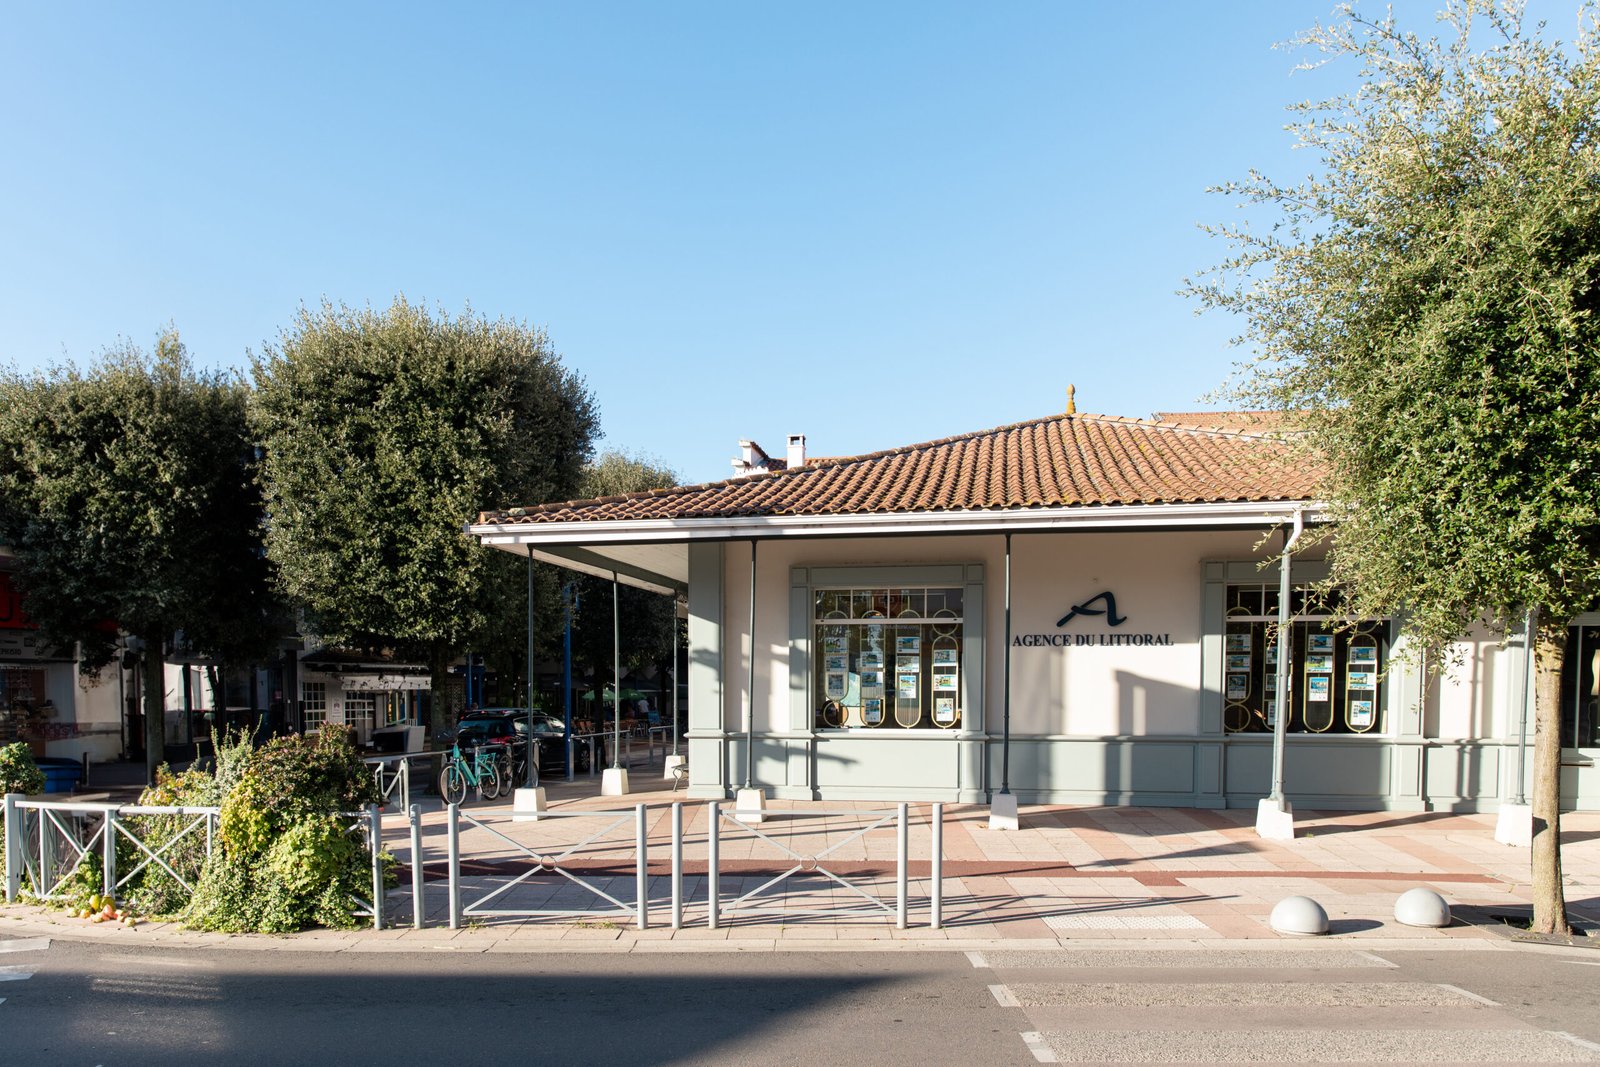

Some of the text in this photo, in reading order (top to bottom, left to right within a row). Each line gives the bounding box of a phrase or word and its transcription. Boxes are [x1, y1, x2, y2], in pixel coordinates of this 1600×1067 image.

[1012, 633, 1174, 647] AGENCE DU LITTORAL
